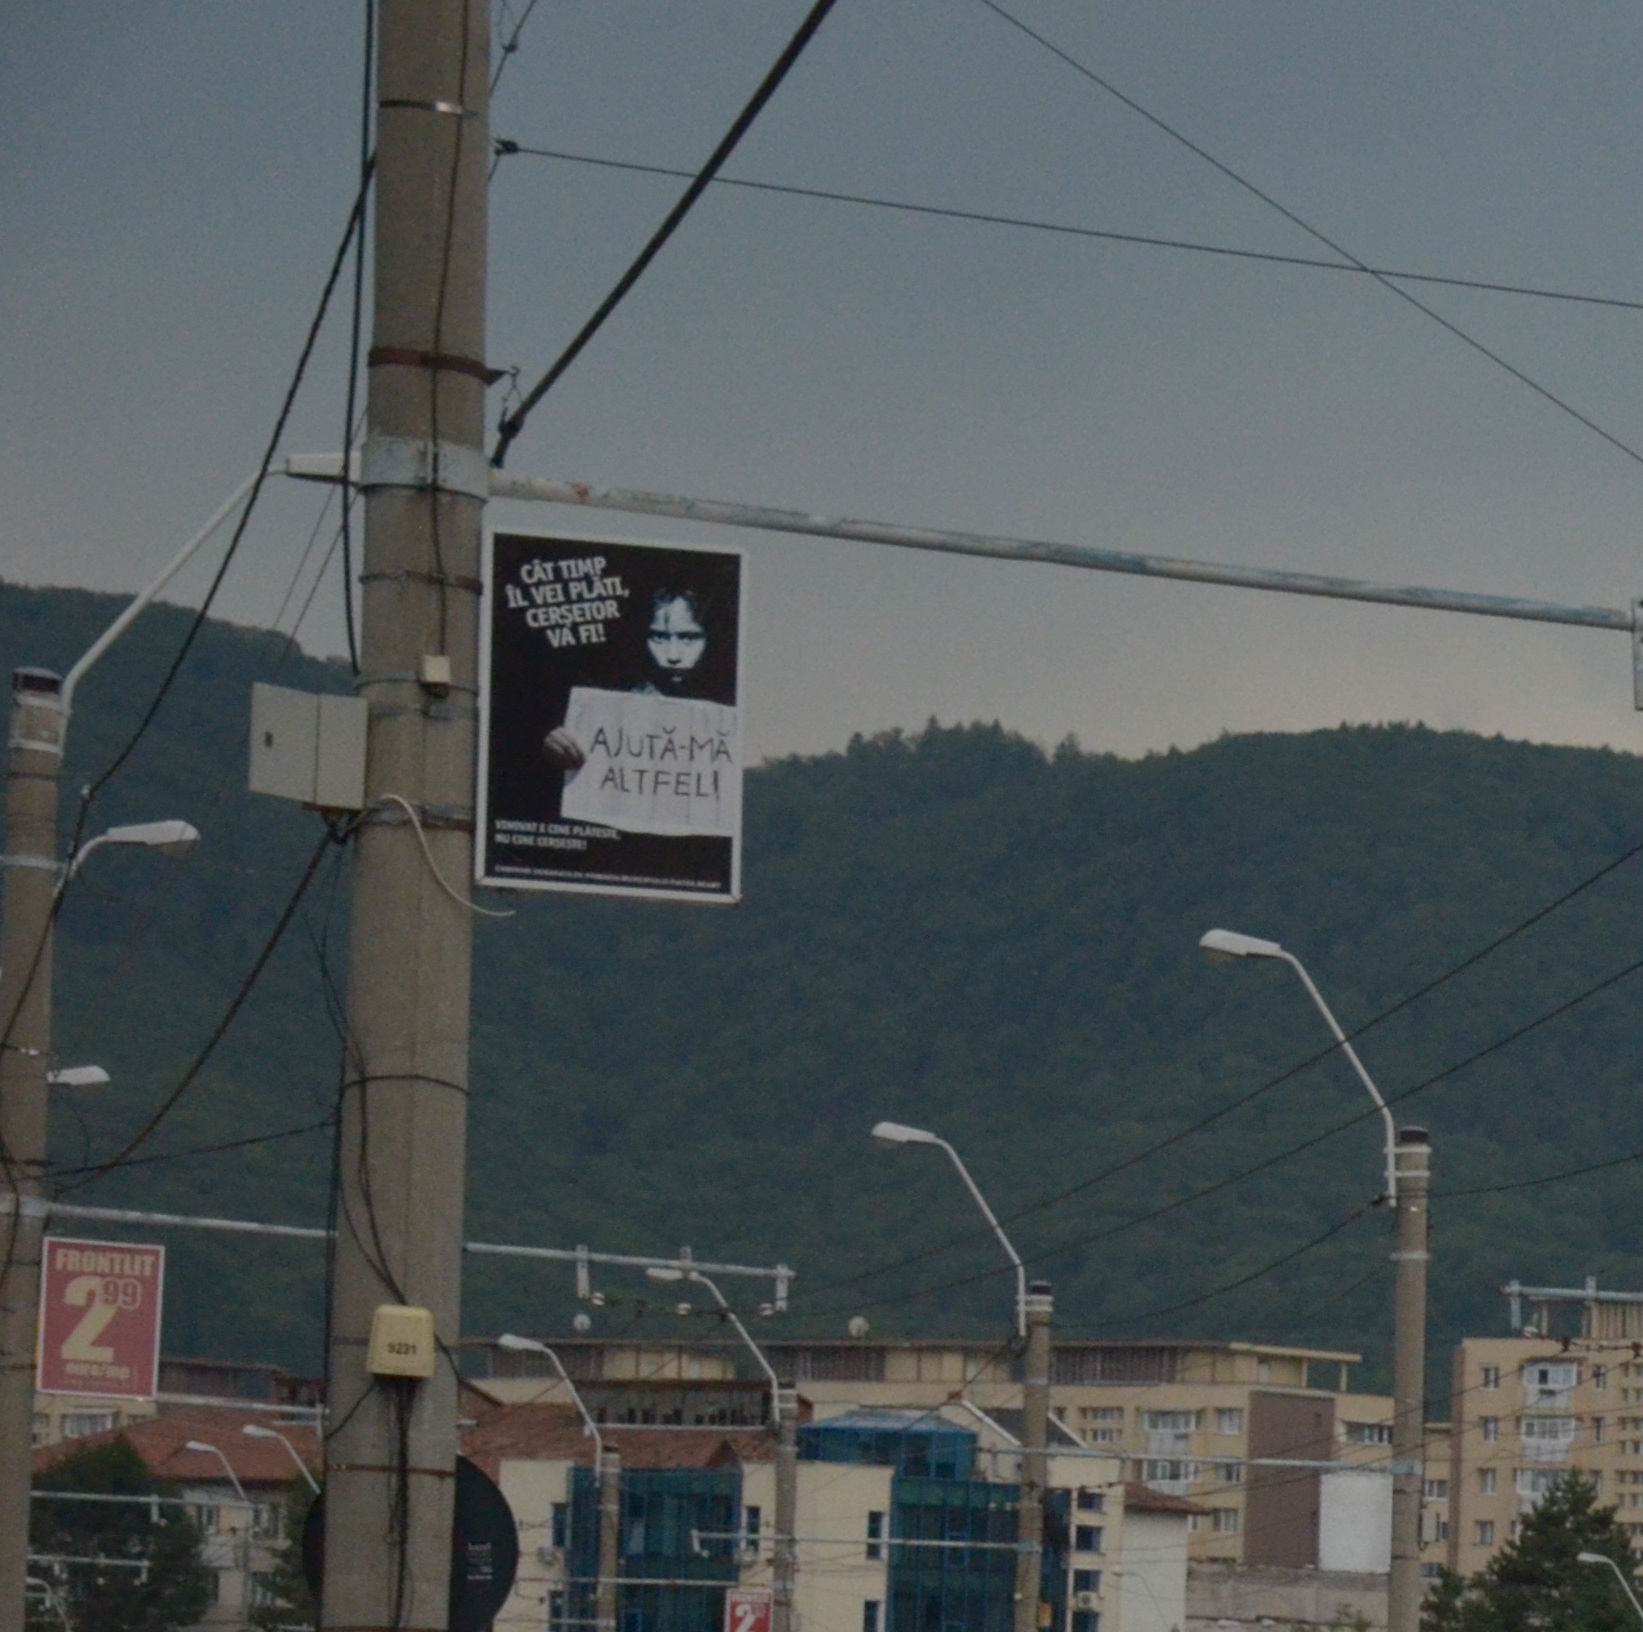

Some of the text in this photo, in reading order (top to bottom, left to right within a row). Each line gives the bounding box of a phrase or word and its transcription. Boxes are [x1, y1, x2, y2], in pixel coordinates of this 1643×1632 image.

[557, 555, 608, 580] TIMP
[504, 583, 530, 608] ÎL
[530, 582, 566, 605] VEI
[578, 621, 608, 645] FI!
[590, 726, 733, 764] AJUTĂ-MĂ
[601, 766, 720, 800] ALTFEL!
[56, 1249, 155, 1277] FRONTLIT
